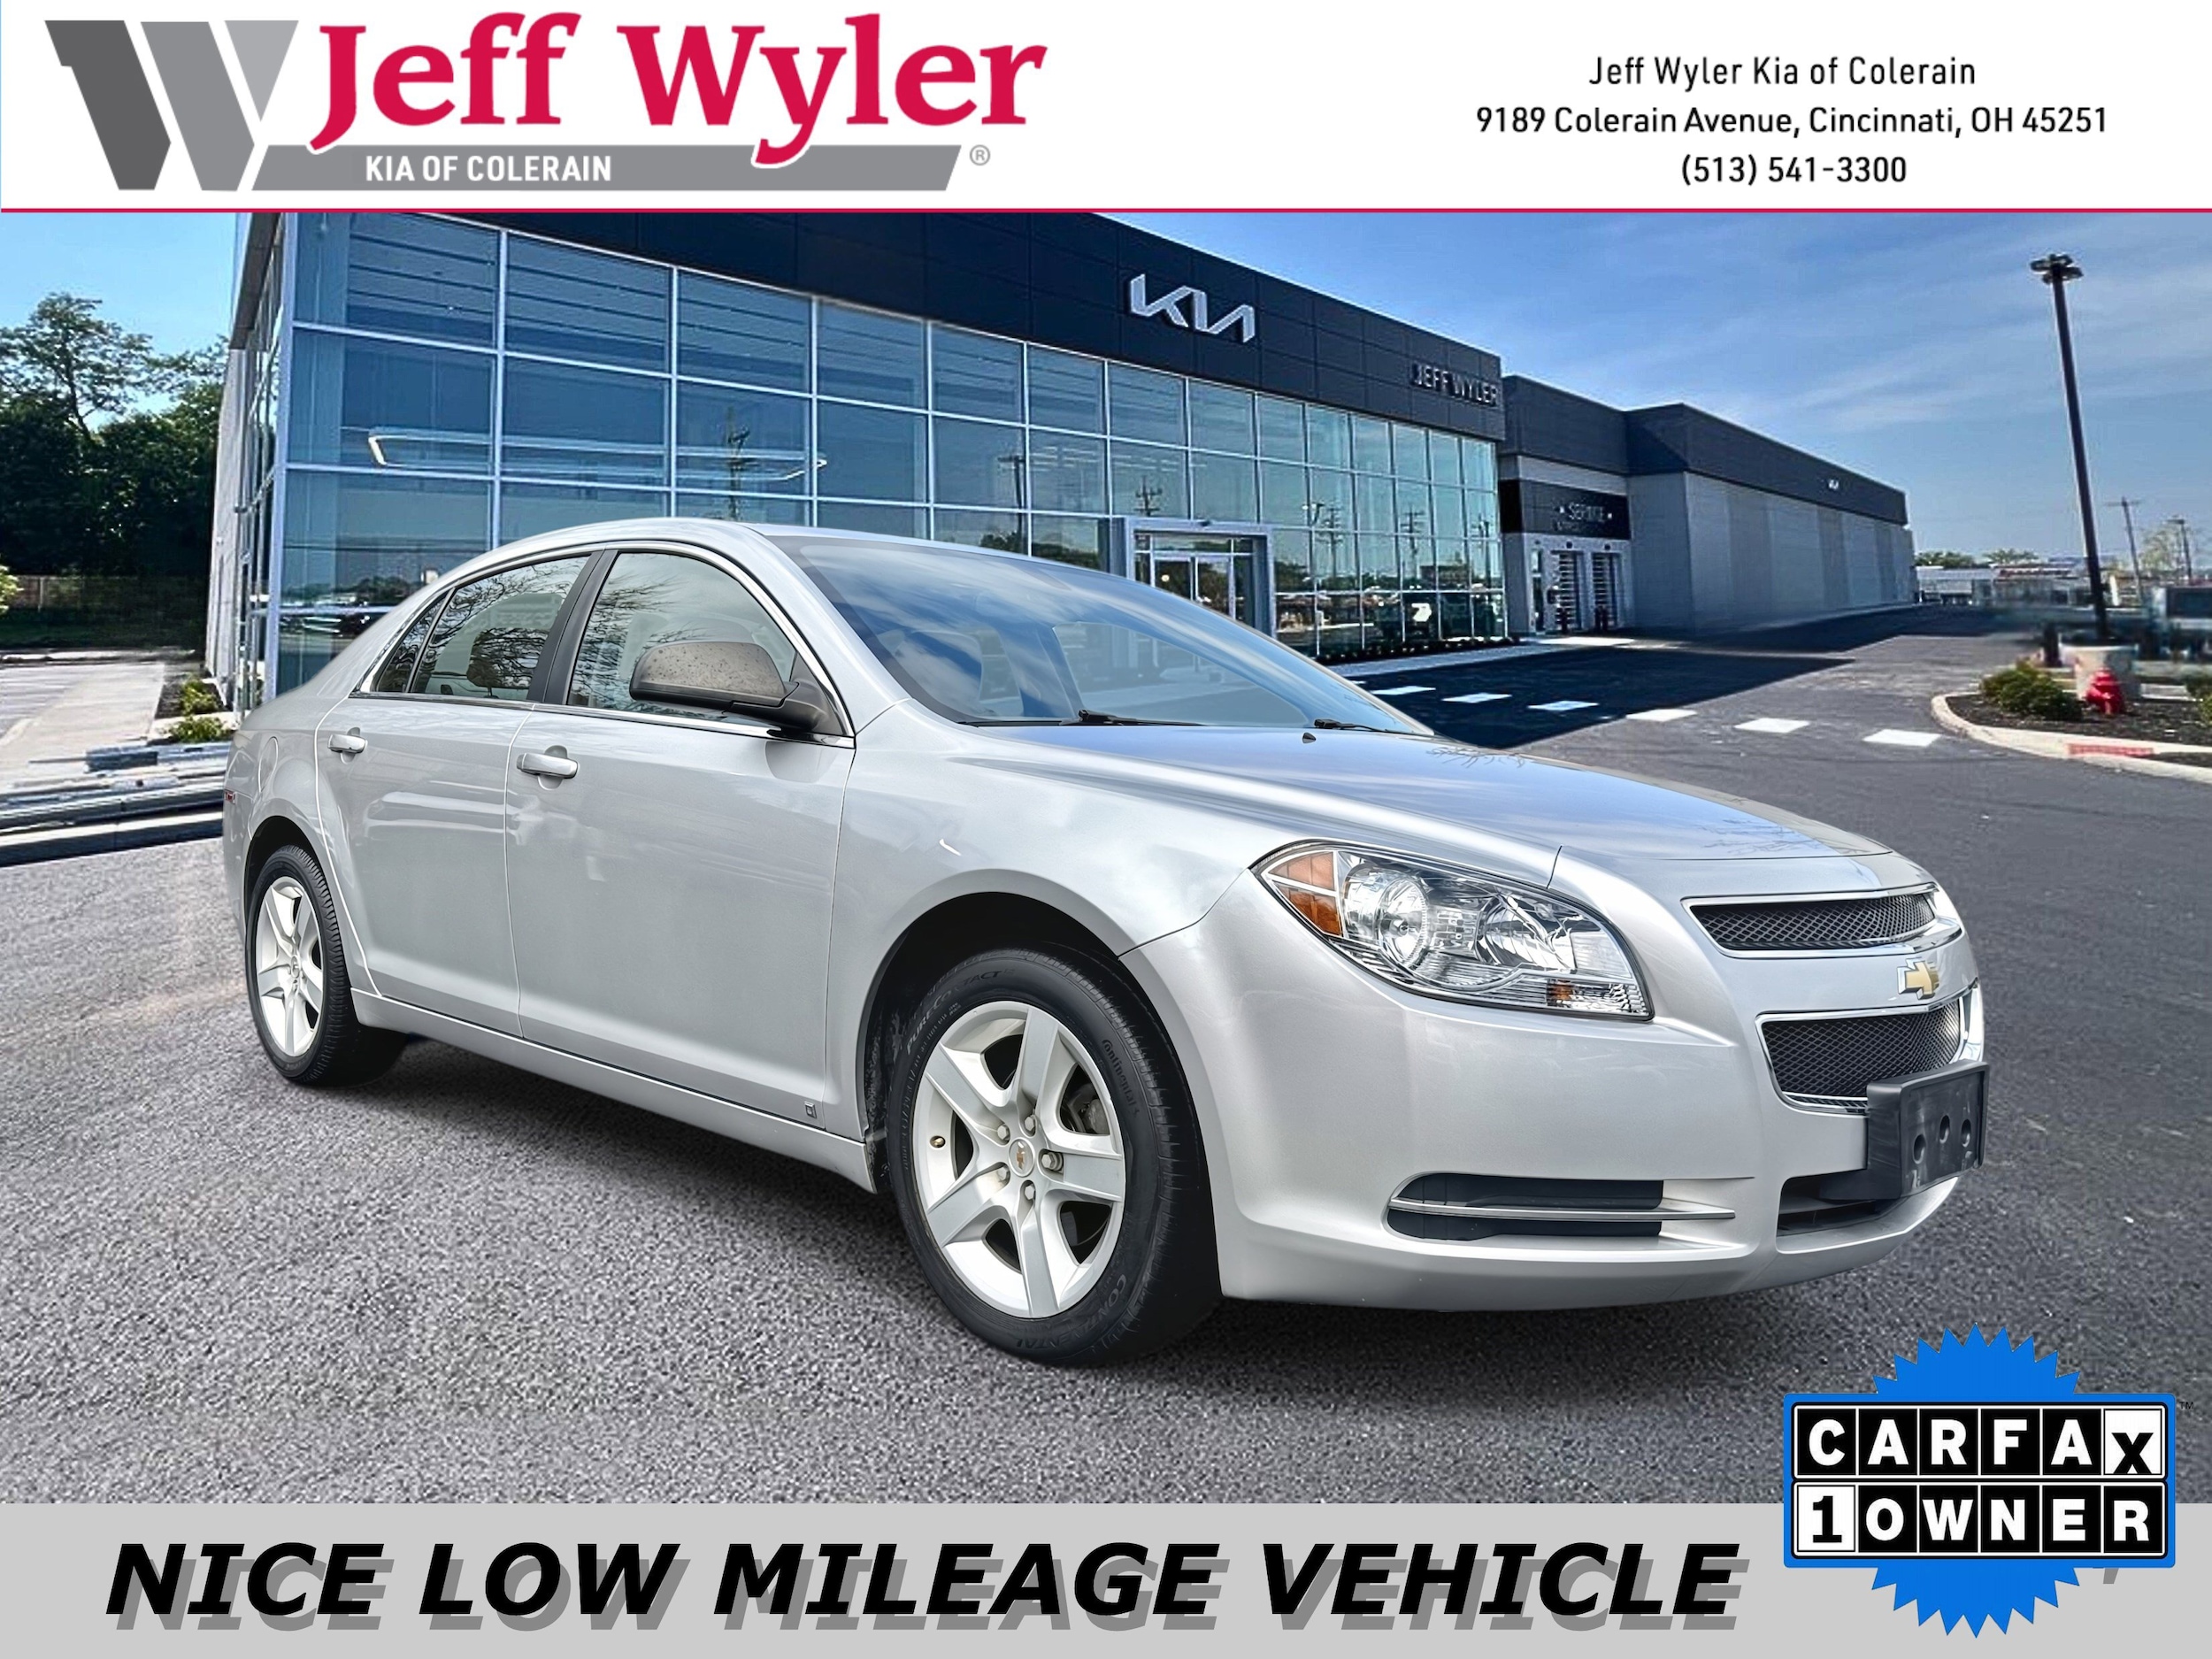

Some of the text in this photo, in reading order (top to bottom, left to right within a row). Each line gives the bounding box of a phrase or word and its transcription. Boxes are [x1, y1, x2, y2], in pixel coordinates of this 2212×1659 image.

[1130, 273, 1256, 343] KIA
[1413, 363, 1498, 406] JEFF WYLER
